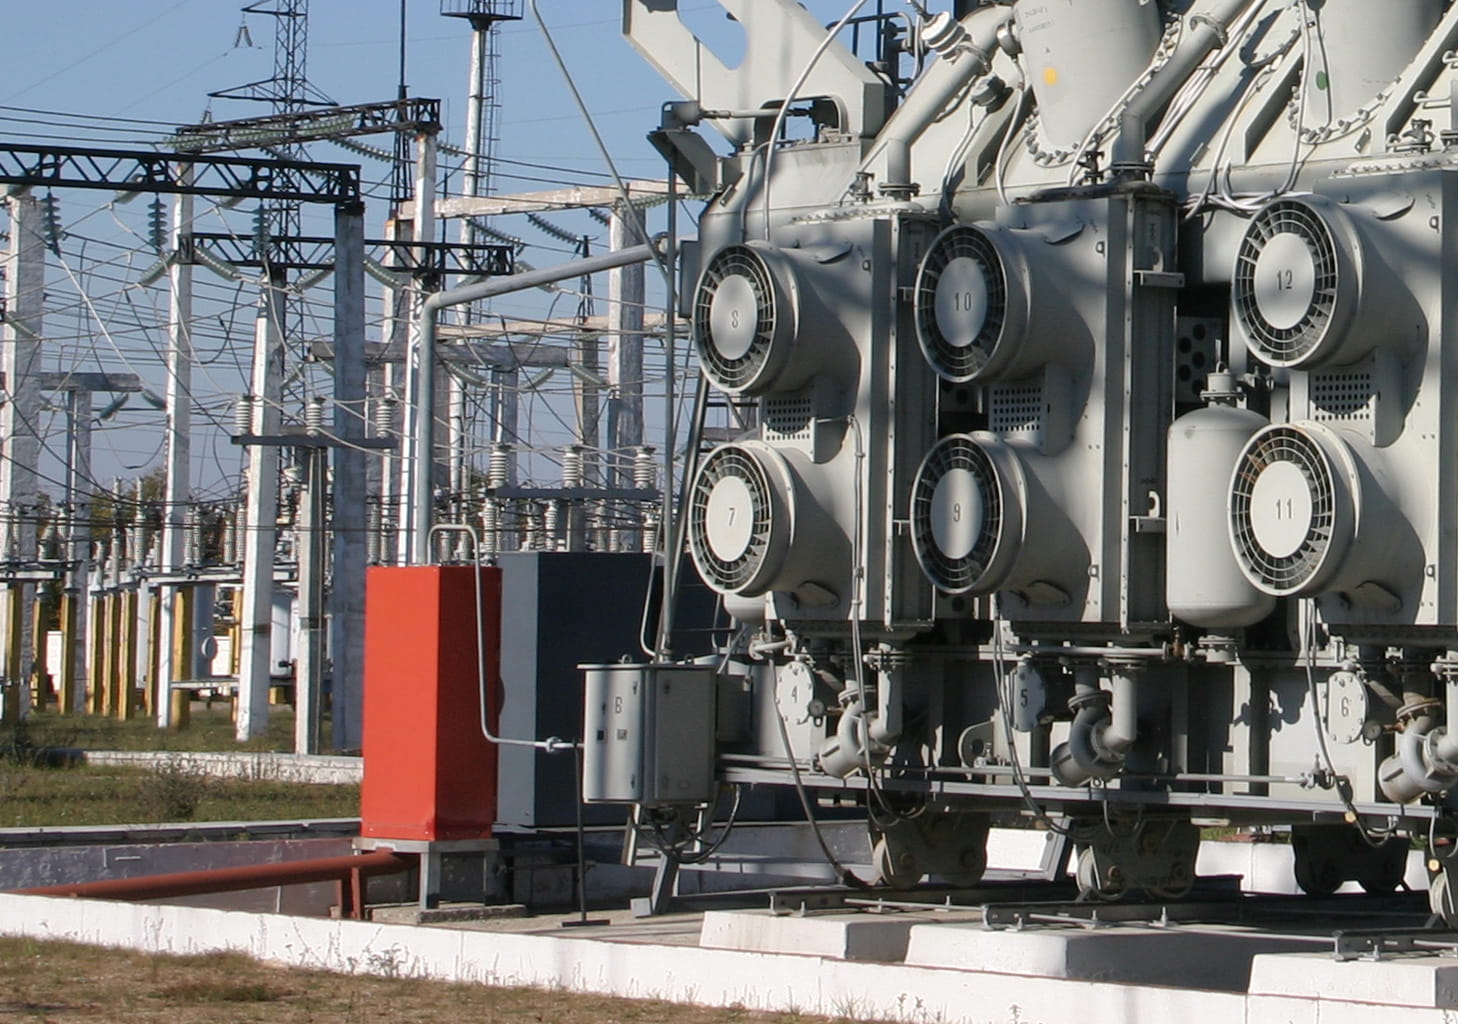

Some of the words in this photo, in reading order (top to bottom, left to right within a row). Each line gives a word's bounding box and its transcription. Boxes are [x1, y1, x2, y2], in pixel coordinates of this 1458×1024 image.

[1276, 270, 1294, 291] 12
[954, 292, 973, 312] 10
[730, 309, 740, 330] 8
[727, 506, 736, 527] 7
[952, 503, 962, 523] 9
[1275, 498, 1294, 520] 11
[790, 685, 798, 704] 4
[1020, 687, 1029, 707] 5
[1340, 696, 1350, 718] 6
